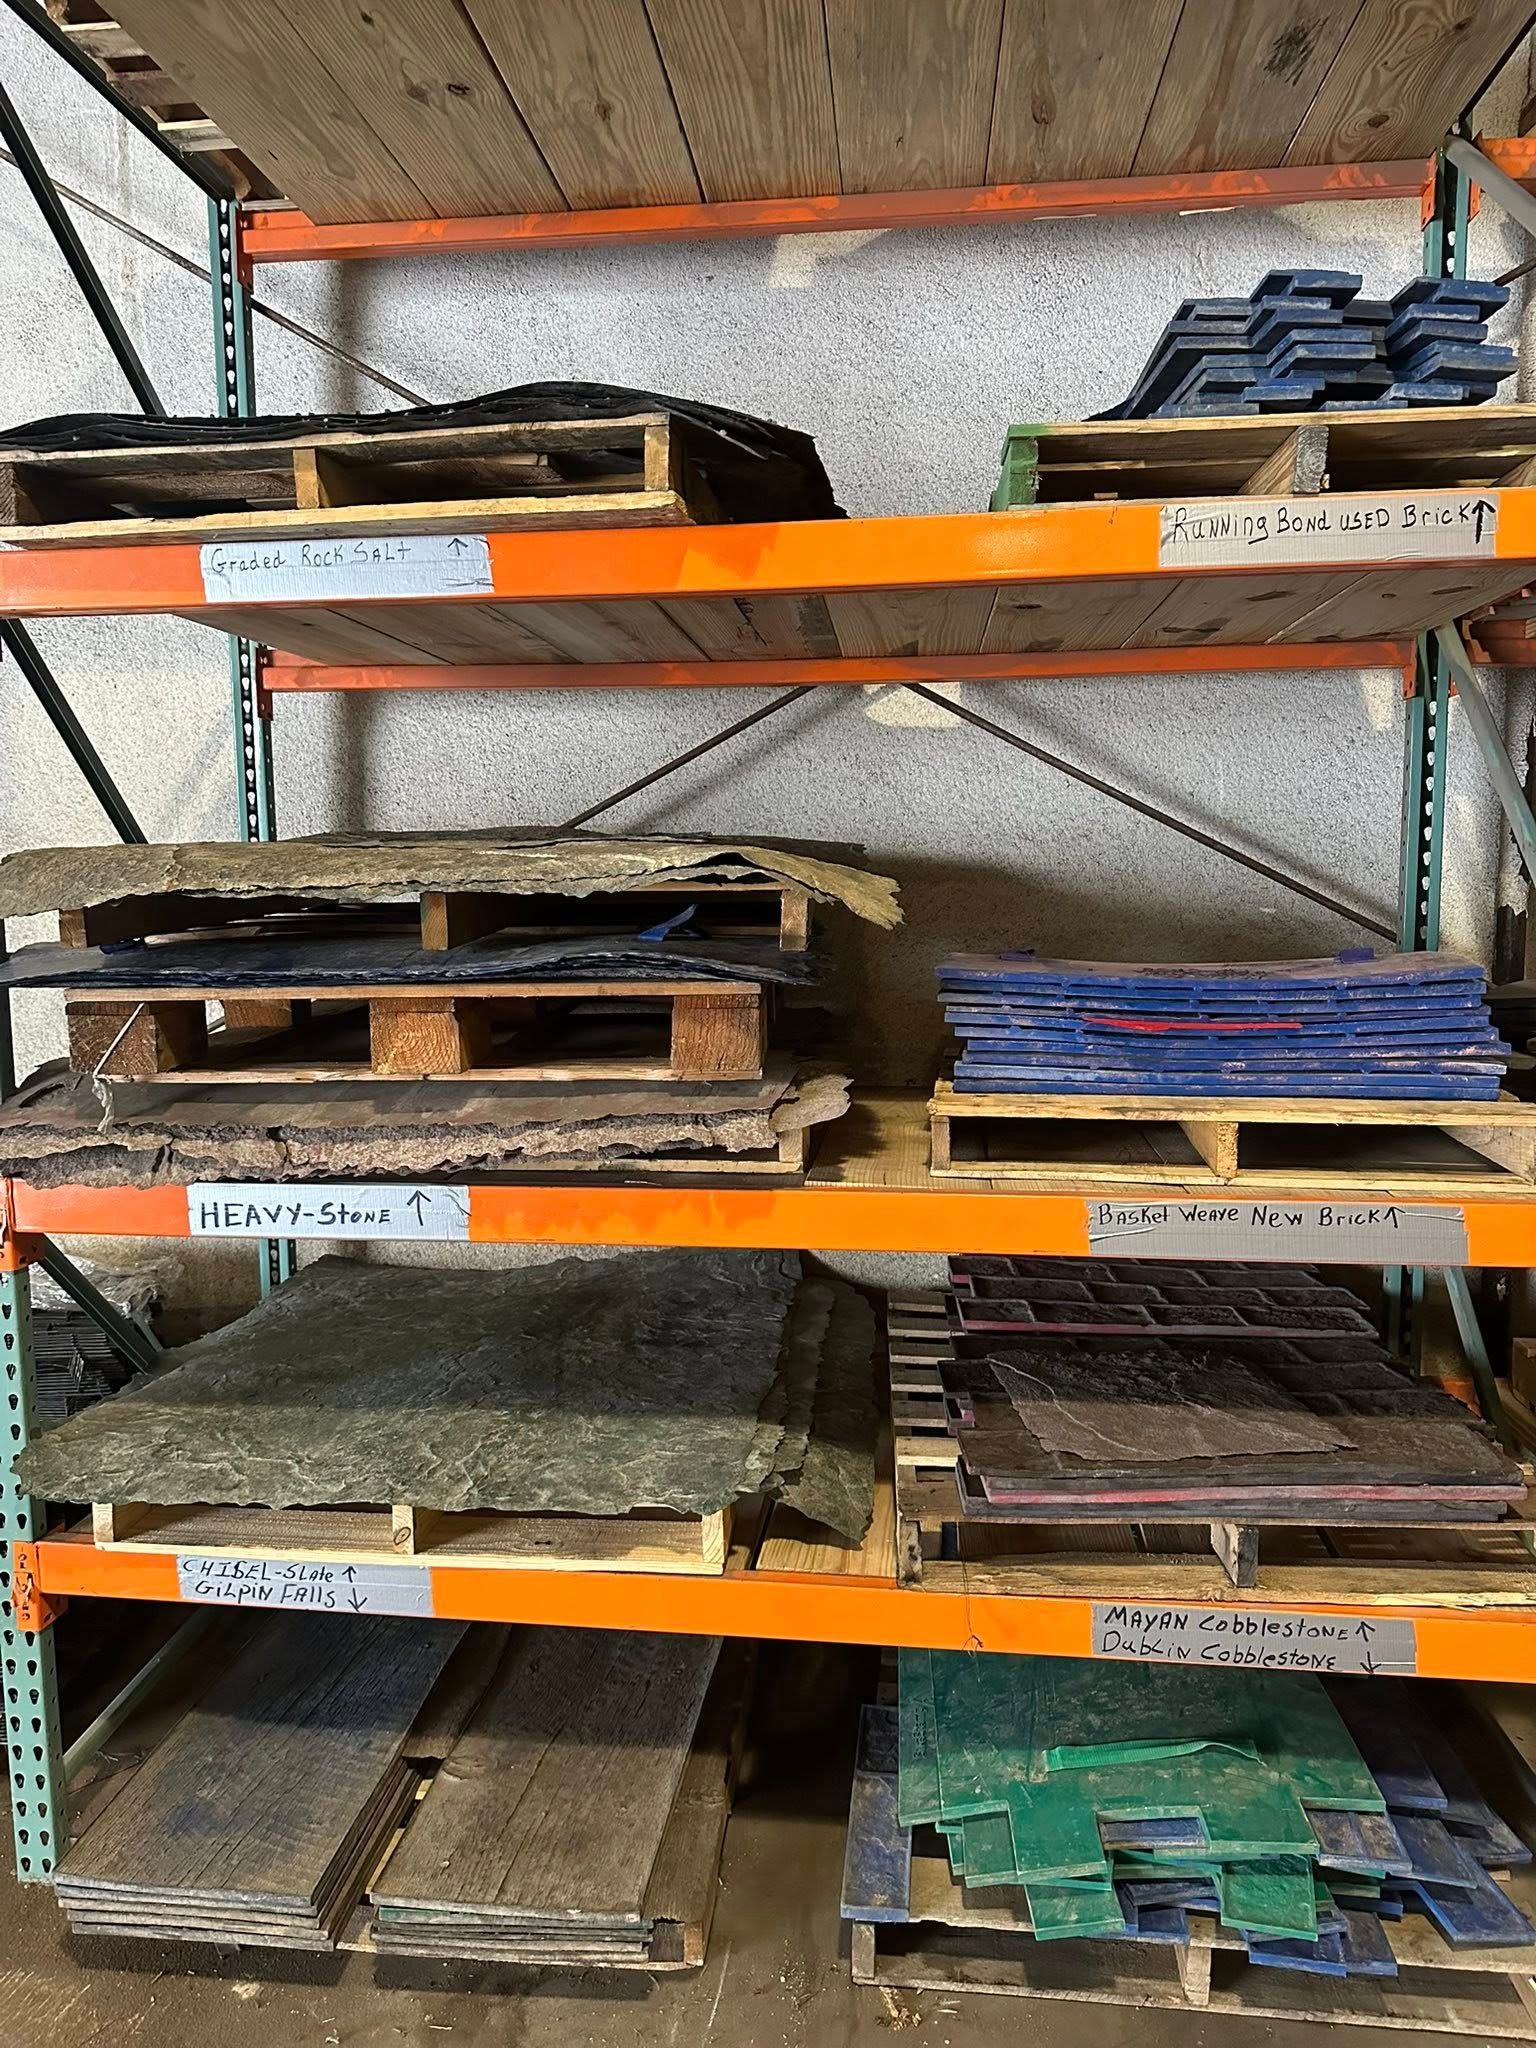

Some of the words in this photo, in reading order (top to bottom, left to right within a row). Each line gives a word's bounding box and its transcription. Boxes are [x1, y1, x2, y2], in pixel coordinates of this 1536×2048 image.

[1402, 503, 1469, 528] Brick
[211, 547, 286, 573] Graded
[1251, 1205, 1303, 1229] New
[1105, 1606, 1188, 1631] MAYAN
